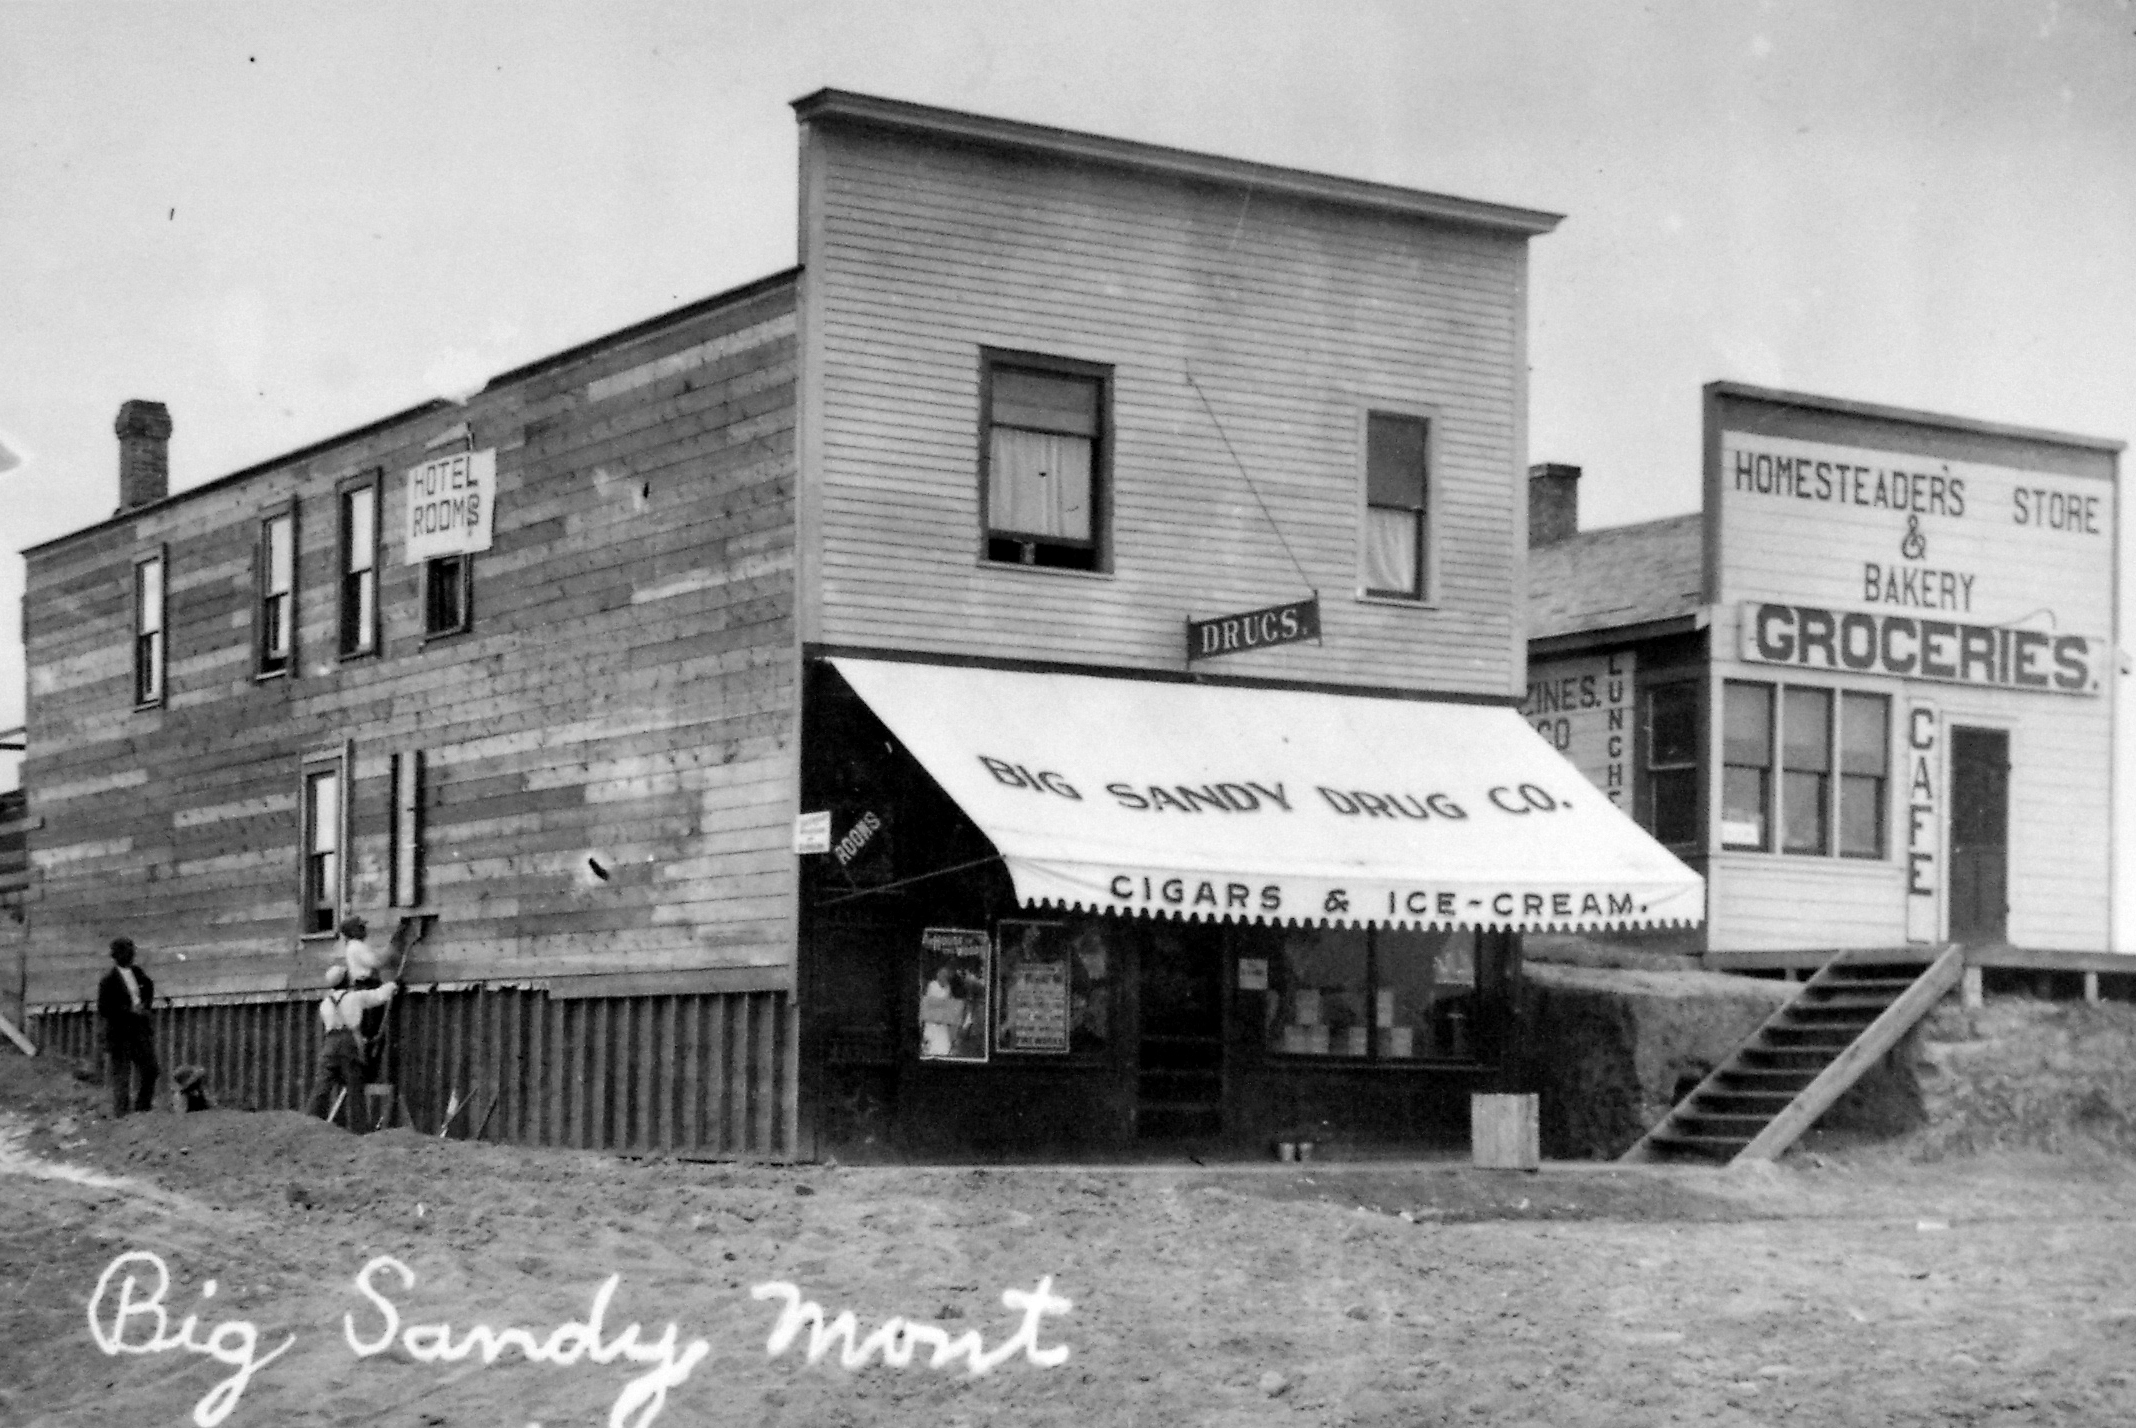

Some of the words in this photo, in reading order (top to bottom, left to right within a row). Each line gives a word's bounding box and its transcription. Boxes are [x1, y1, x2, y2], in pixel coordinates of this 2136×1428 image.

[413, 456, 478, 499] HOTEL
[413, 493, 480, 537] ROOMS
[2013, 486, 2100, 534] STORE
[1900, 514, 1927, 560] &
[1864, 562, 1975, 611] BAKERY
[978, 754, 1084, 801] BIG
[1105, 781, 1293, 814] SANDY
[1315, 785, 1469, 821] DRUG
[1487, 783, 1574, 813] CO.
[1908, 707, 1934, 896] CAFE
[834, 810, 881, 866] ROOMS
[1110, 874, 1282, 911] CIGARS
[1323, 888, 1350, 914] &
